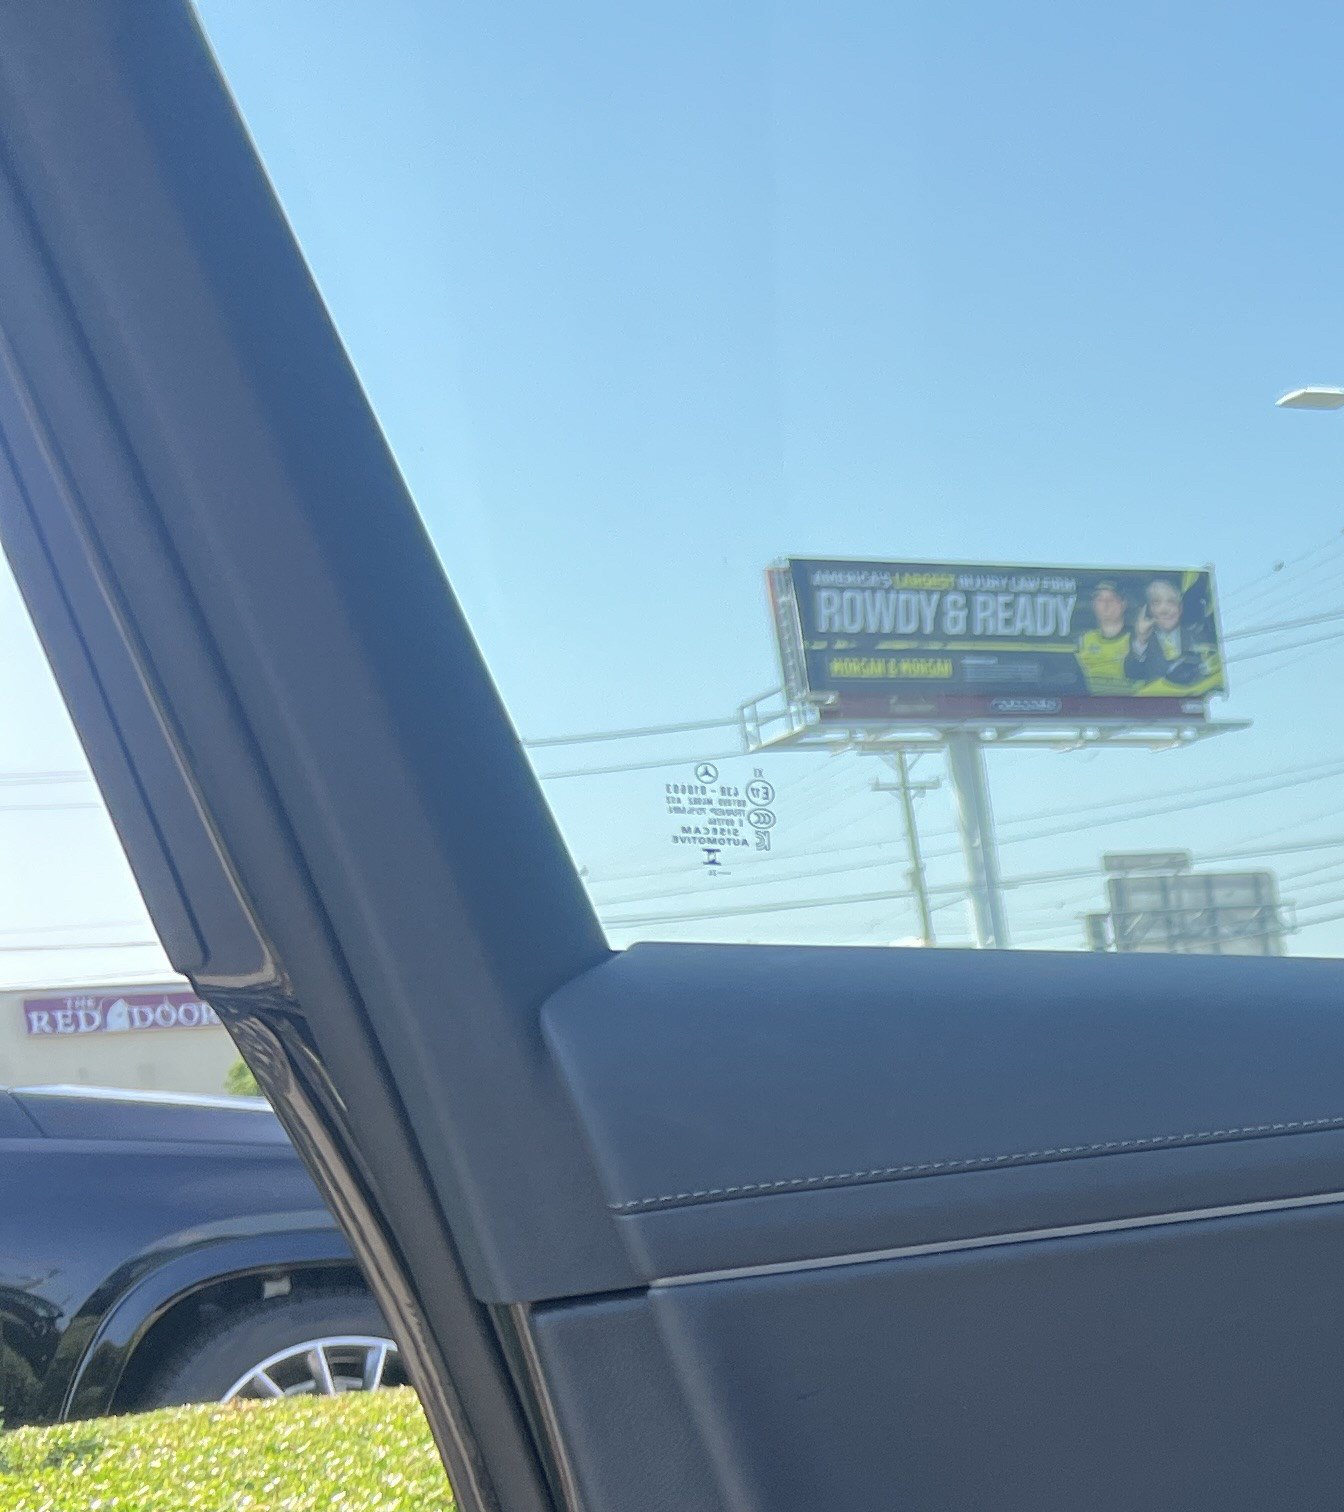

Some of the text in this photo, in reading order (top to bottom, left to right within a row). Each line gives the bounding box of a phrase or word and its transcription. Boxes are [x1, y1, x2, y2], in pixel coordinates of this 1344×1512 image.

[817, 589, 1077, 636] ROWDY & READY
[28, 1011, 100, 1034] RED
